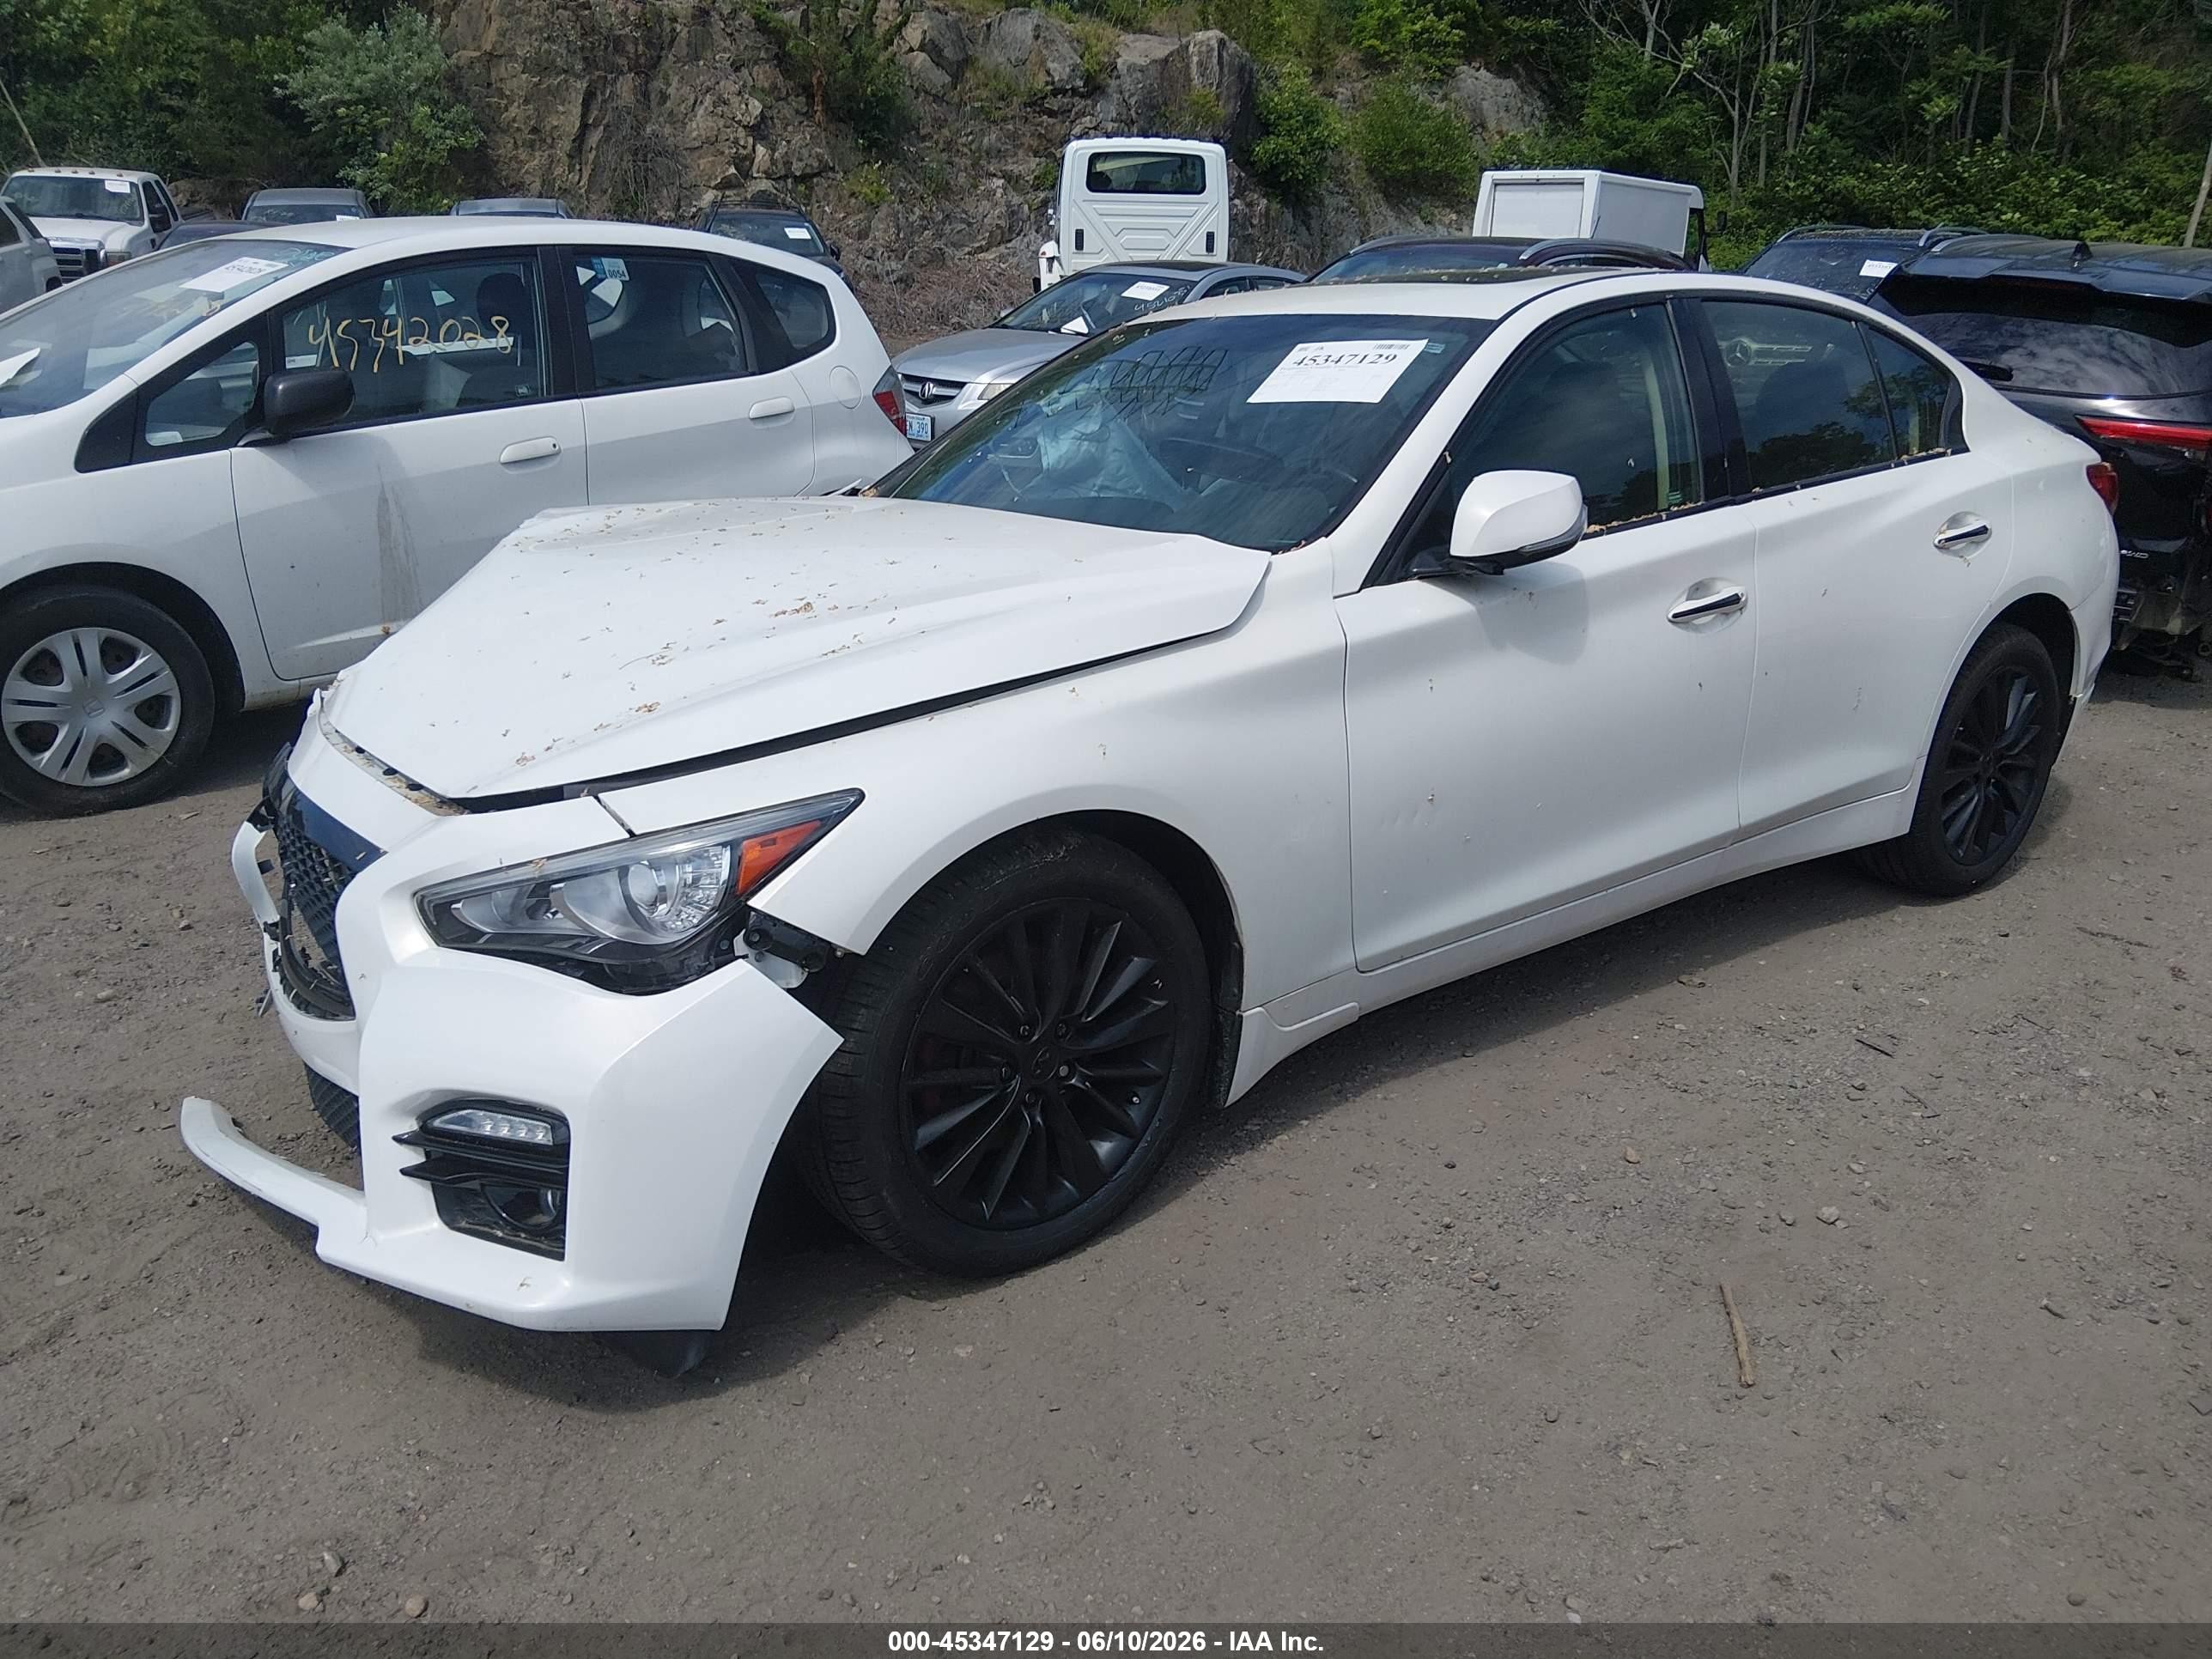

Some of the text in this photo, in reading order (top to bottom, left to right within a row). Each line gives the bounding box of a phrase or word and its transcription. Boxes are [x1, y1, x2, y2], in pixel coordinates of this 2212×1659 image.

[308, 315, 514, 374] 45342028
[1291, 352, 1399, 367] 45347129
[917, 421, 929, 434] 390
